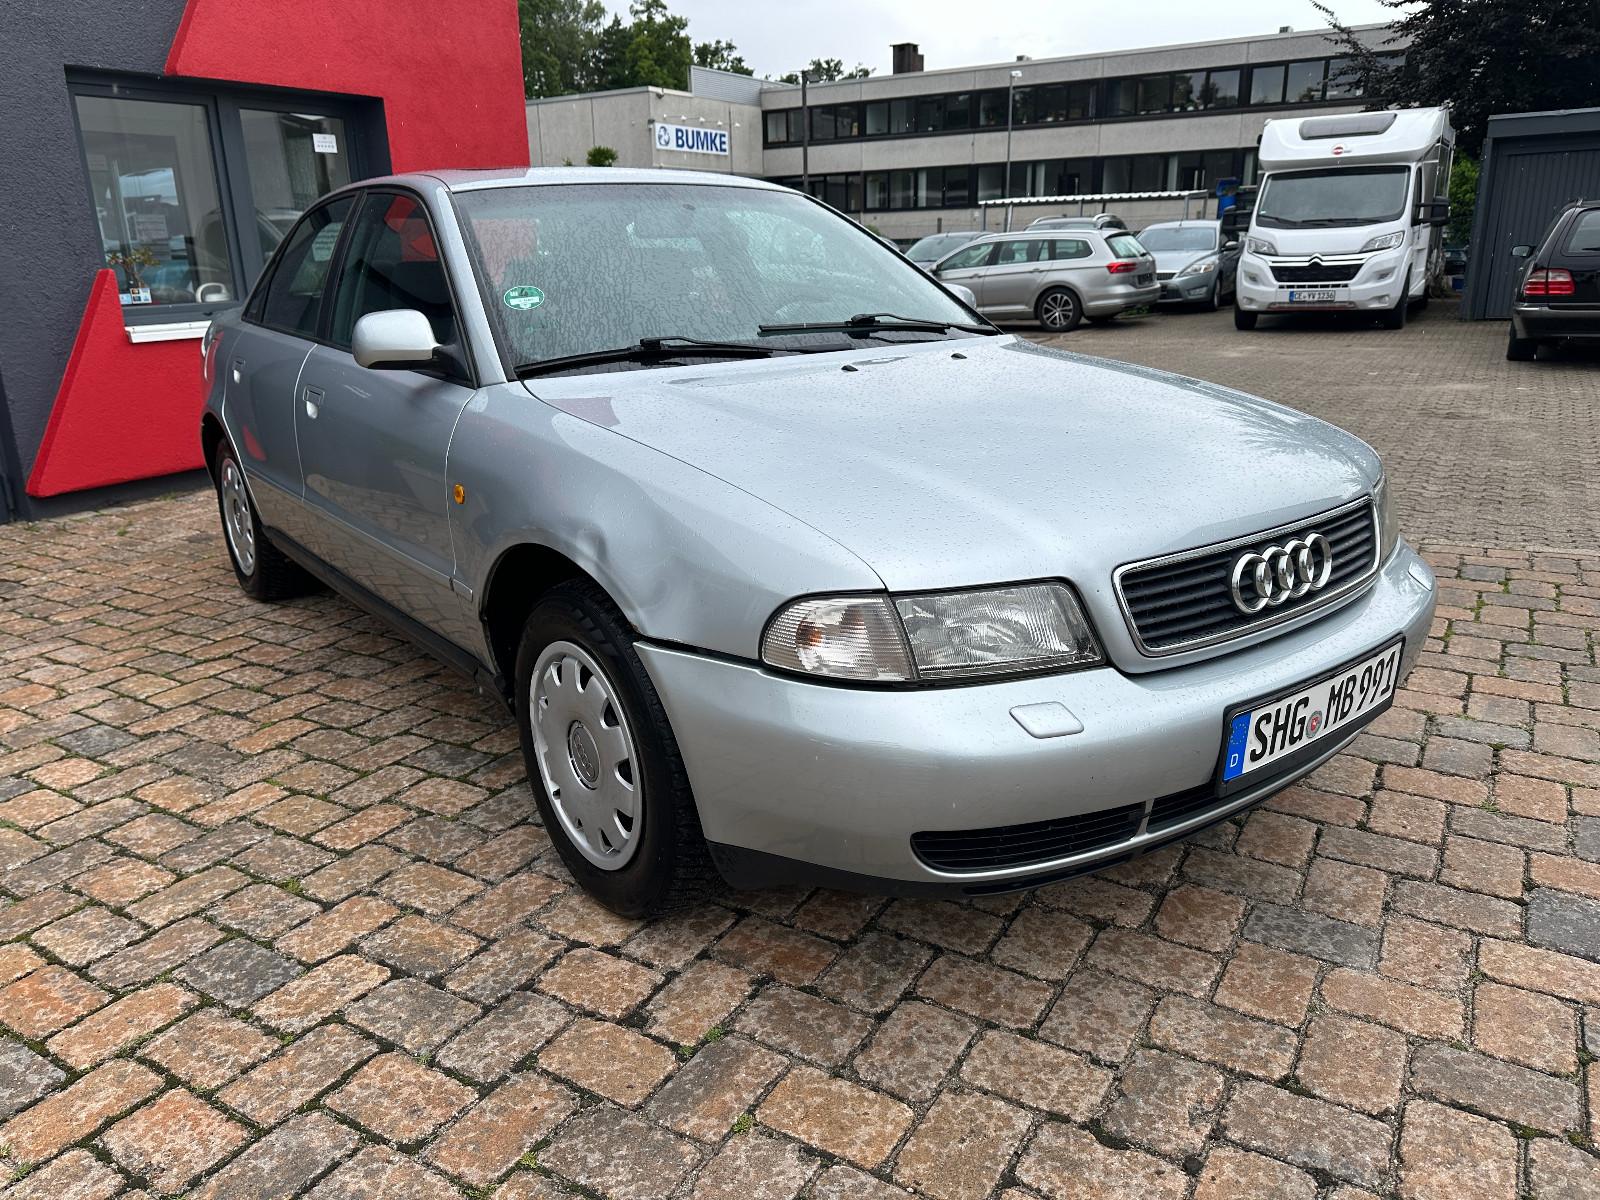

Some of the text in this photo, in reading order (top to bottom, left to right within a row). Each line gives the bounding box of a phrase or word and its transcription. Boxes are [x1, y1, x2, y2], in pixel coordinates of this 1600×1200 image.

[675, 128, 727, 152] BUMKE
[1250, 697, 1310, 762] SHG
[1230, 754, 1239, 768] D
